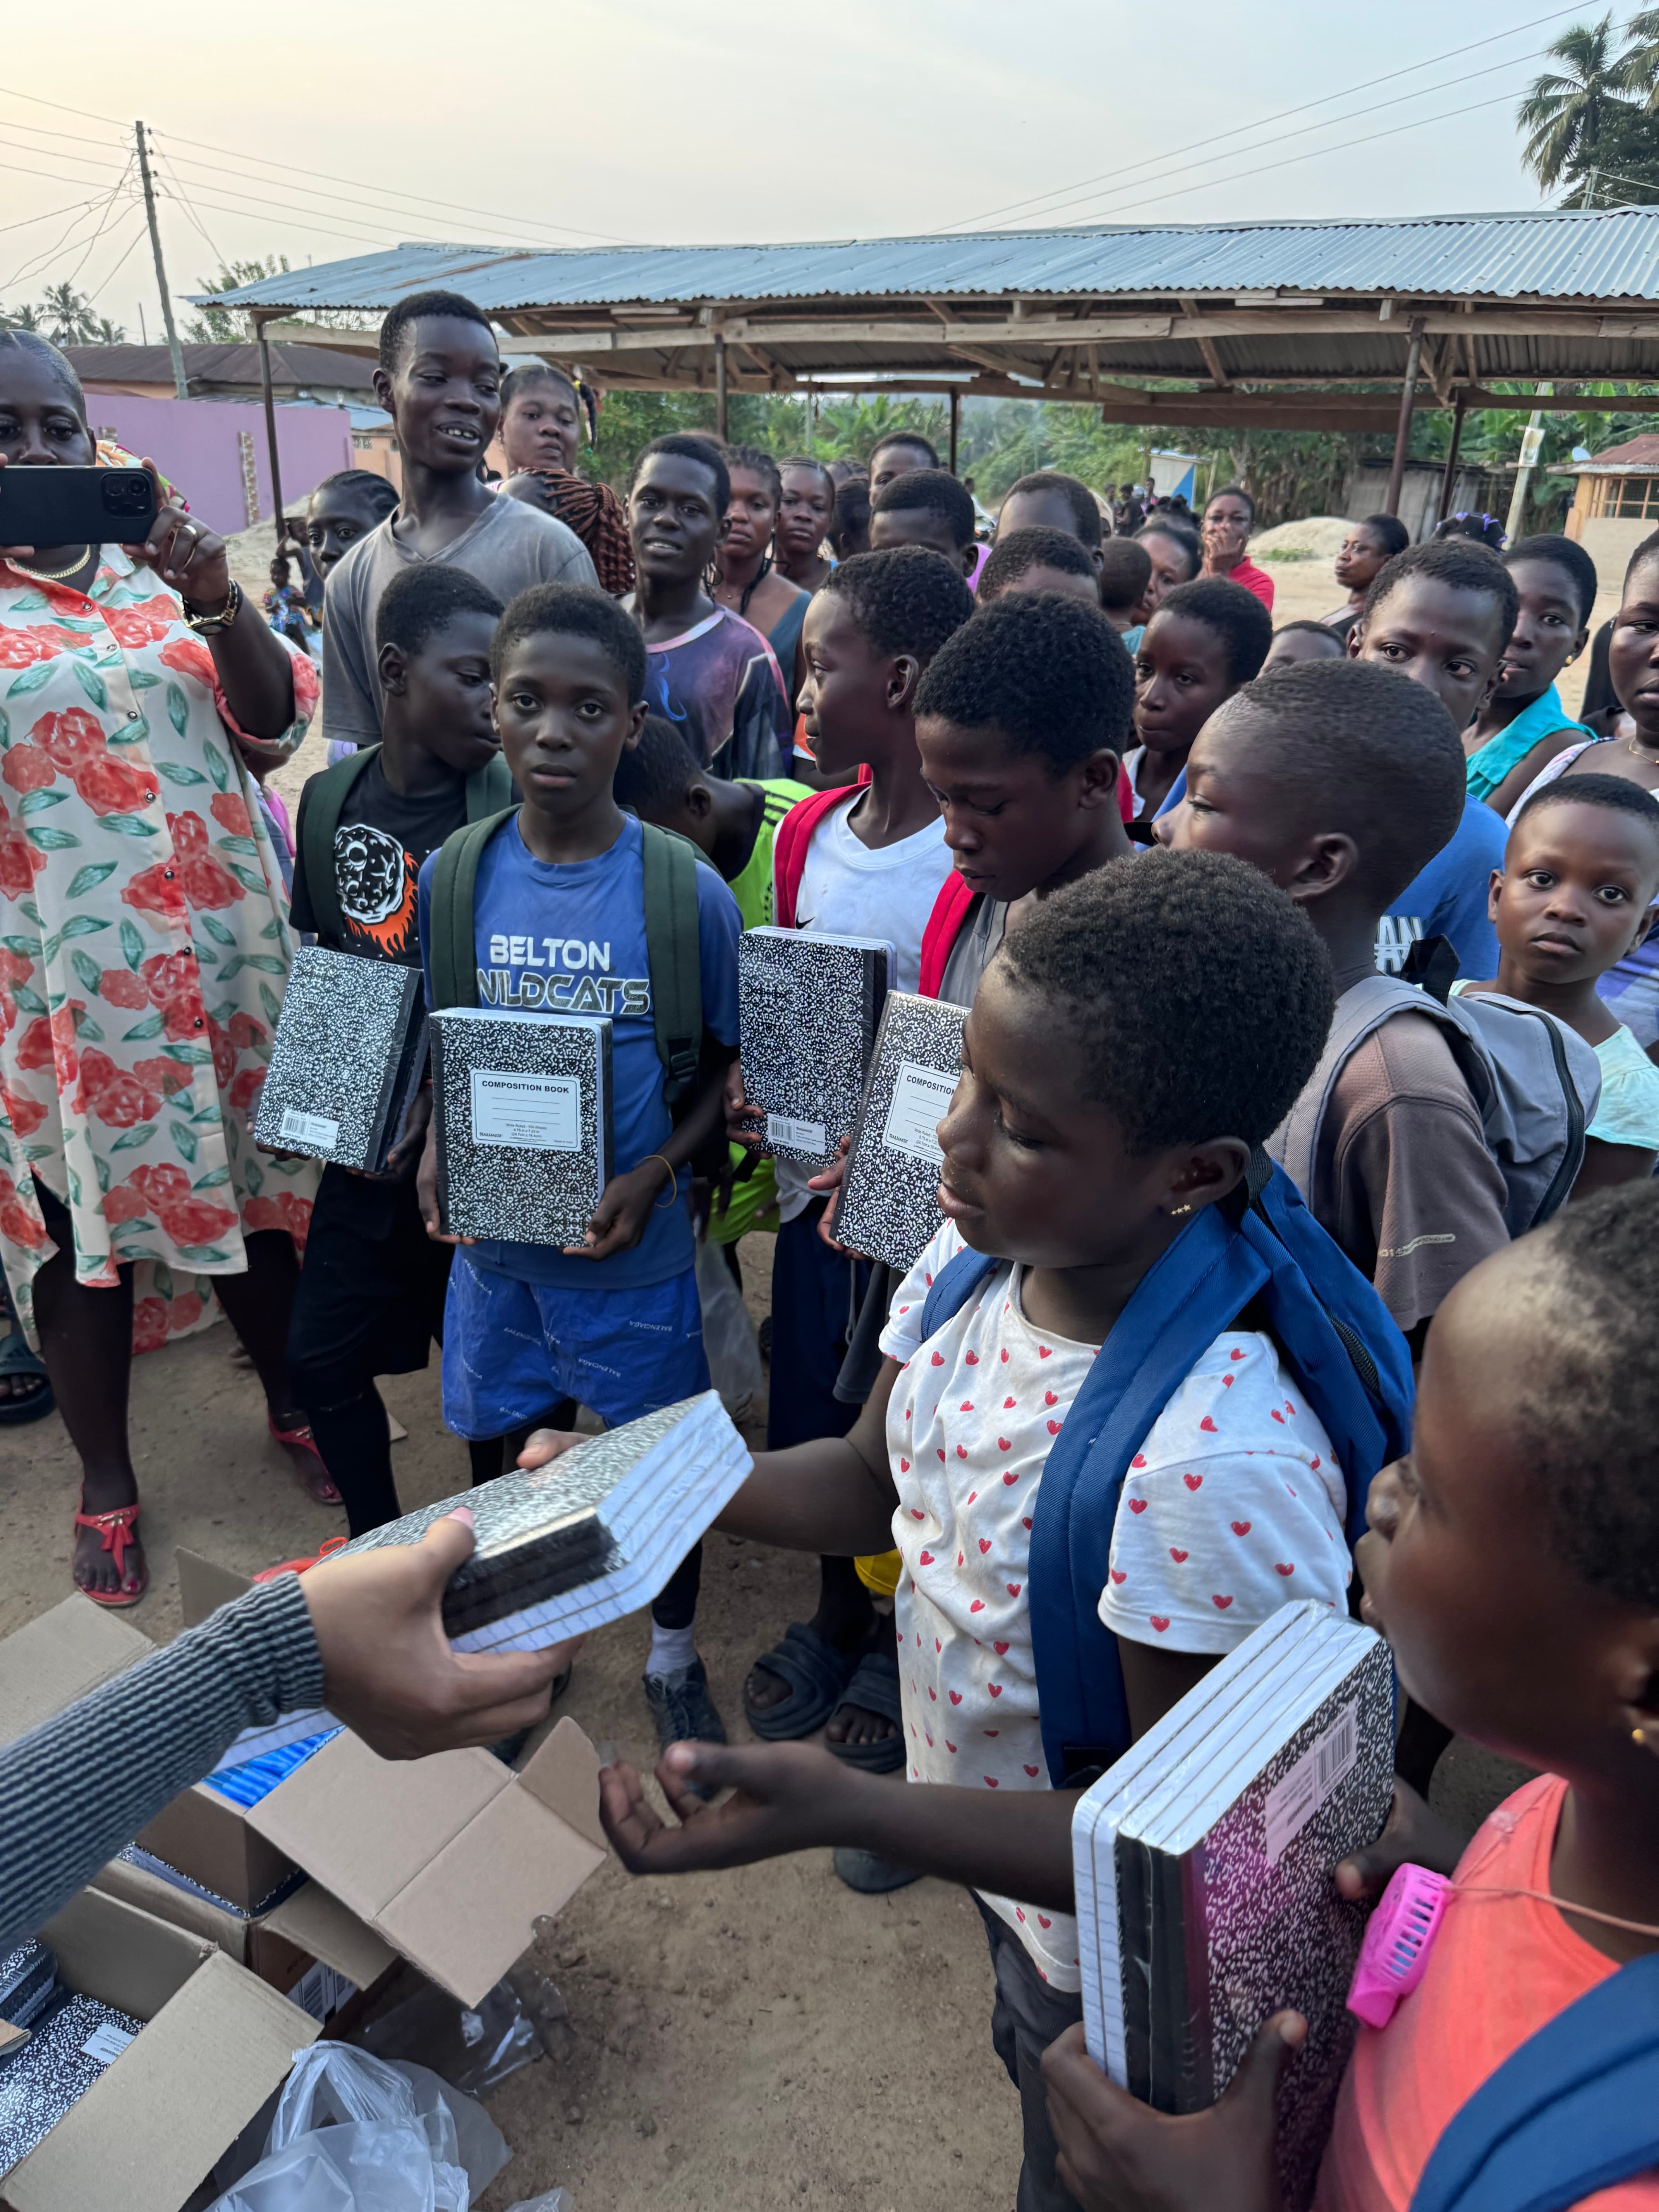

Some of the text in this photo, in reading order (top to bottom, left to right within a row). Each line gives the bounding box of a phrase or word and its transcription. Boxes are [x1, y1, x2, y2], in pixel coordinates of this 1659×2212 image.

[490, 934, 610, 972] BELTON
[482, 1080, 569, 1094] COMPOSITION BOOK
[629, 1320, 673, 1331] BALENCIAGA
[579, 1358, 621, 1377] BALENCIAGA
